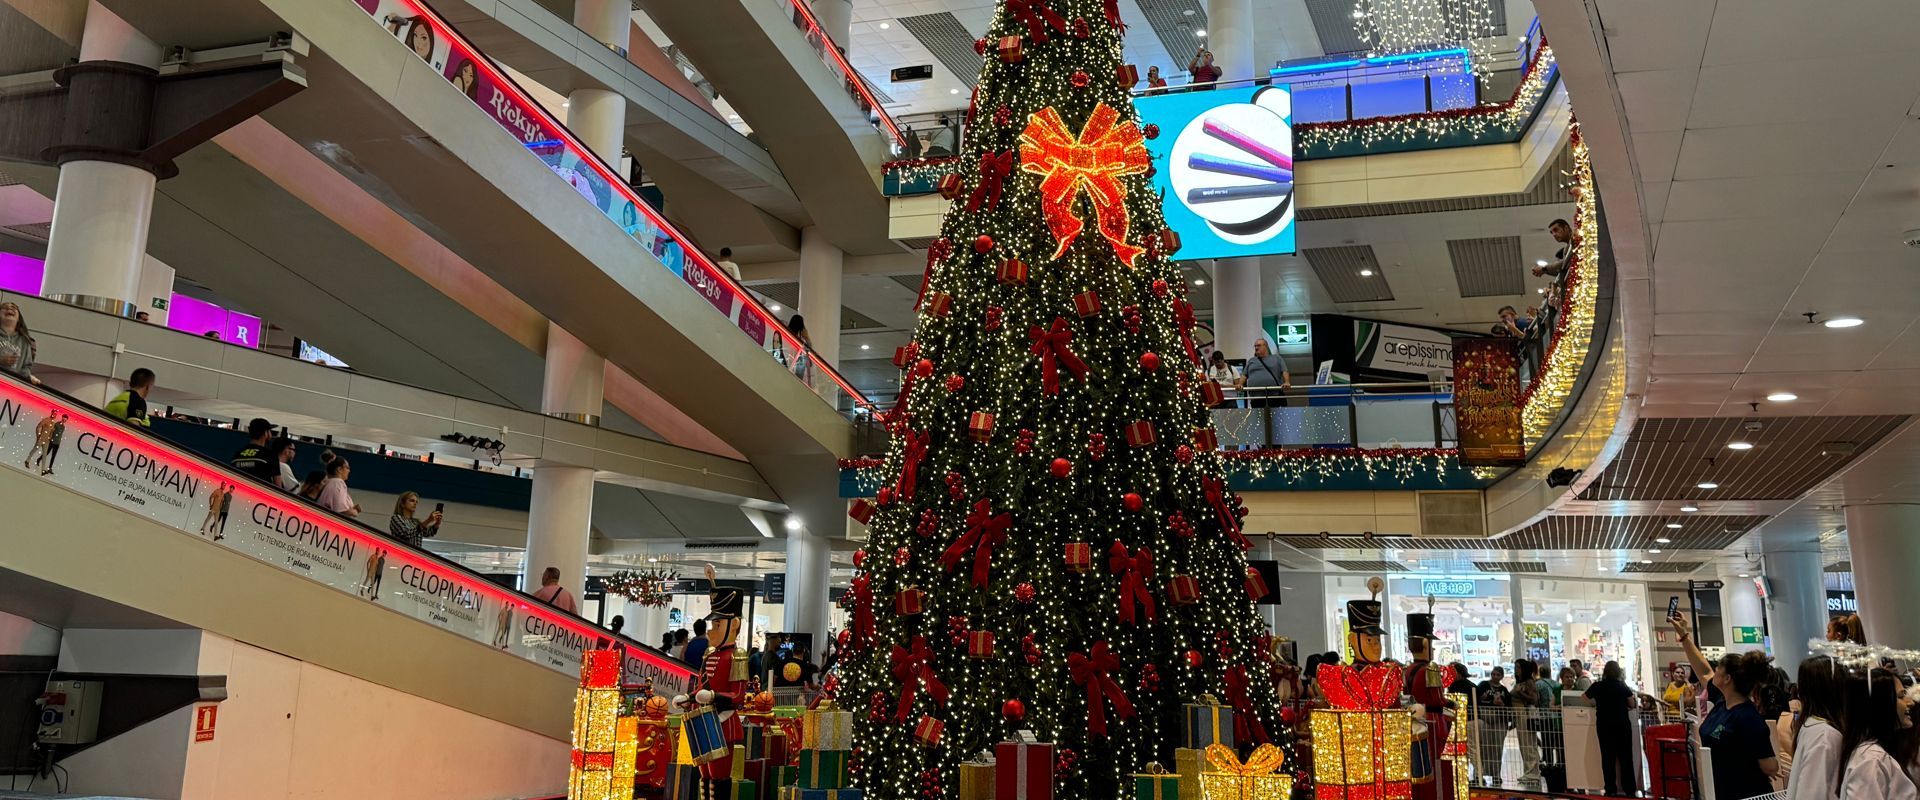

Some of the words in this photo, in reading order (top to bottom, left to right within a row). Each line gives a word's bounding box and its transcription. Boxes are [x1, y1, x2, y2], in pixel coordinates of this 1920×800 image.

[683, 254, 722, 300] Ricky's
[236, 325, 249, 344] R
[1406, 358, 1425, 367] snack
[1427, 360, 1438, 369] bar
[77, 432, 199, 498] CELOPMAN
[83, 462, 93, 472] TU
[93, 466, 118, 482] TIENDA
[118, 477, 129, 487] DE
[128, 481, 146, 494] ROPA
[146, 488, 183, 508] MASCULINA
[124, 491, 146, 506] planta
[252, 502, 356, 561] CELOPMAN
[266, 535, 287, 550] TIENDA
[286, 544, 295, 553] DE
[296, 547, 311, 559] ROPA
[311, 553, 342, 571] MASCULINA
[292, 558, 311, 571] planta
[400, 564, 484, 613] CELOPMAN
[1425, 582, 1473, 594] ALE-HOP
[525, 615, 593, 652] CELOPMAN
[626, 656, 683, 693] CELOPMAN
